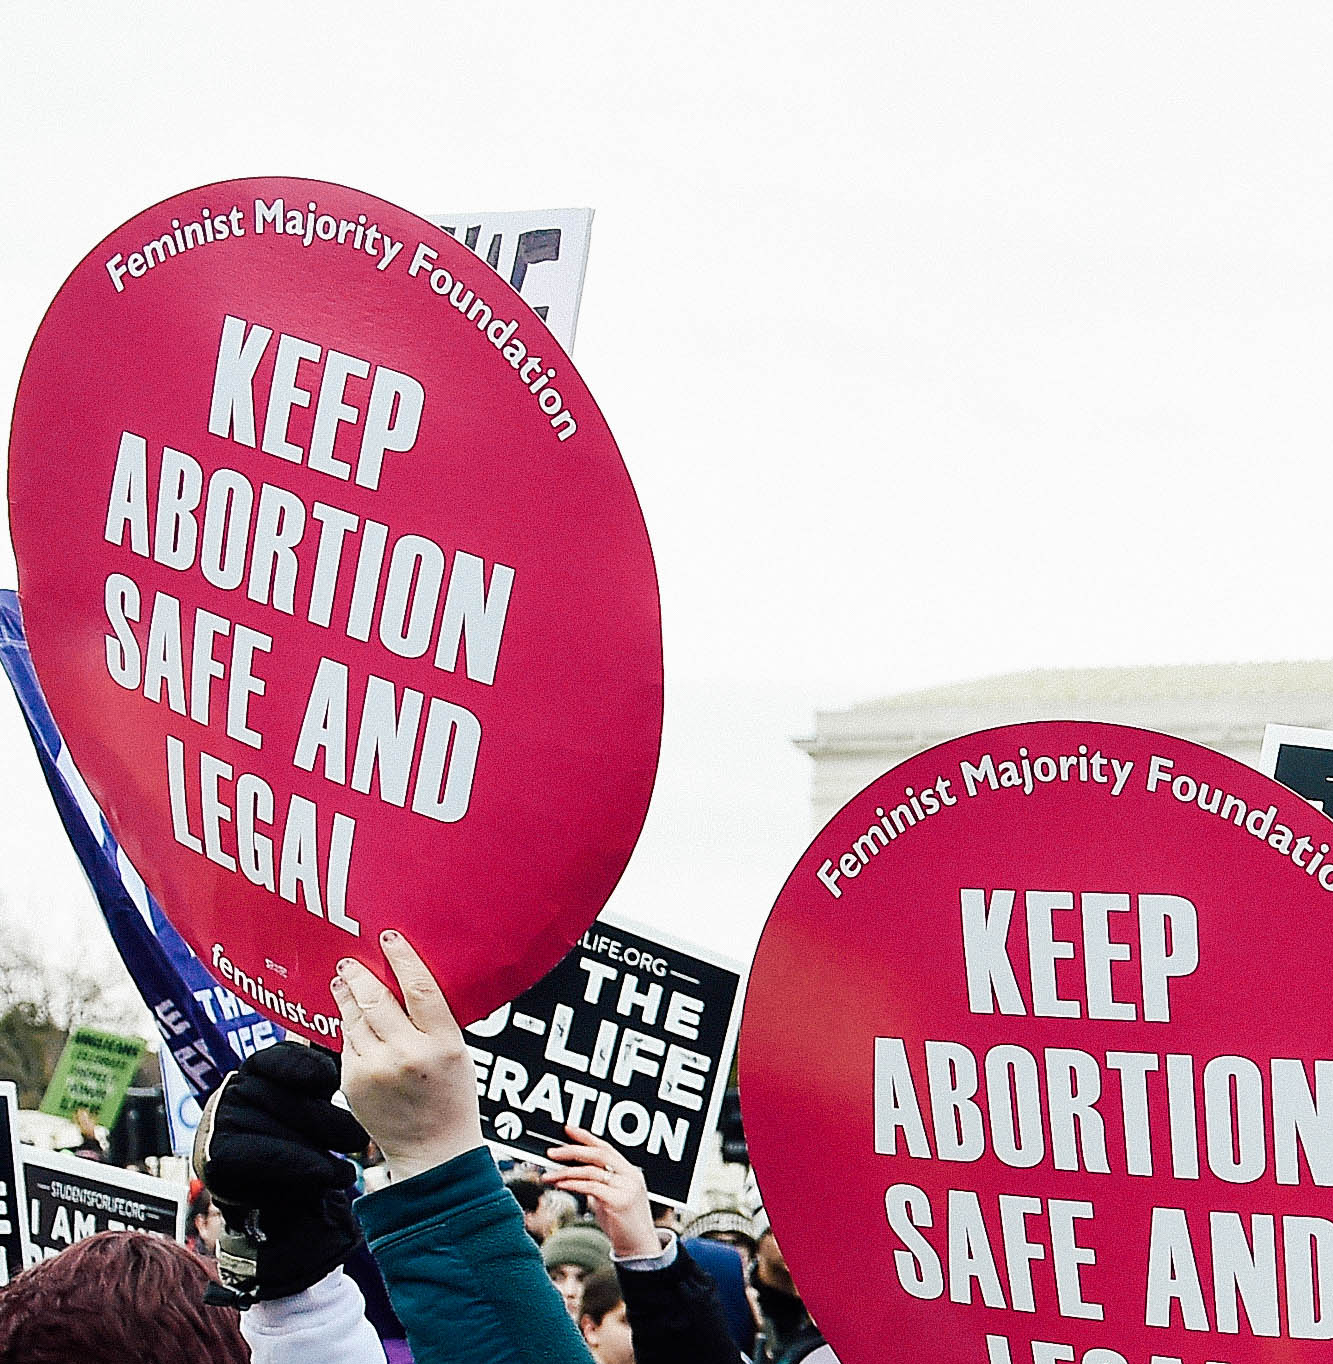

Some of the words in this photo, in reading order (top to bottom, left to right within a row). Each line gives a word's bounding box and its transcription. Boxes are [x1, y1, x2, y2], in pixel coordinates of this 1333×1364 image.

[106, 207, 244, 292] Feminist
[255, 199, 403, 270] Majority
[409, 243, 576, 440] Foundation
[209, 315, 424, 490] KEEP
[105, 432, 515, 685] ABORTION
[105, 574, 272, 749] SAFE
[293, 657, 482, 822] AND
[167, 736, 359, 936] LEGAL
[817, 776, 957, 898] Feminist
[960, 751, 1133, 796] Majority
[211, 943, 342, 1038] feminist.or
[580, 957, 705, 1041] THE
[961, 889, 1198, 1022] KEEP
[31, 1198, 41, 1236] I
[51, 1205, 96, 1245] AM
[50, 1181, 146, 1221] STUDENTSFORLIFE.ORG
[885, 1184, 1103, 1320] SAFE
